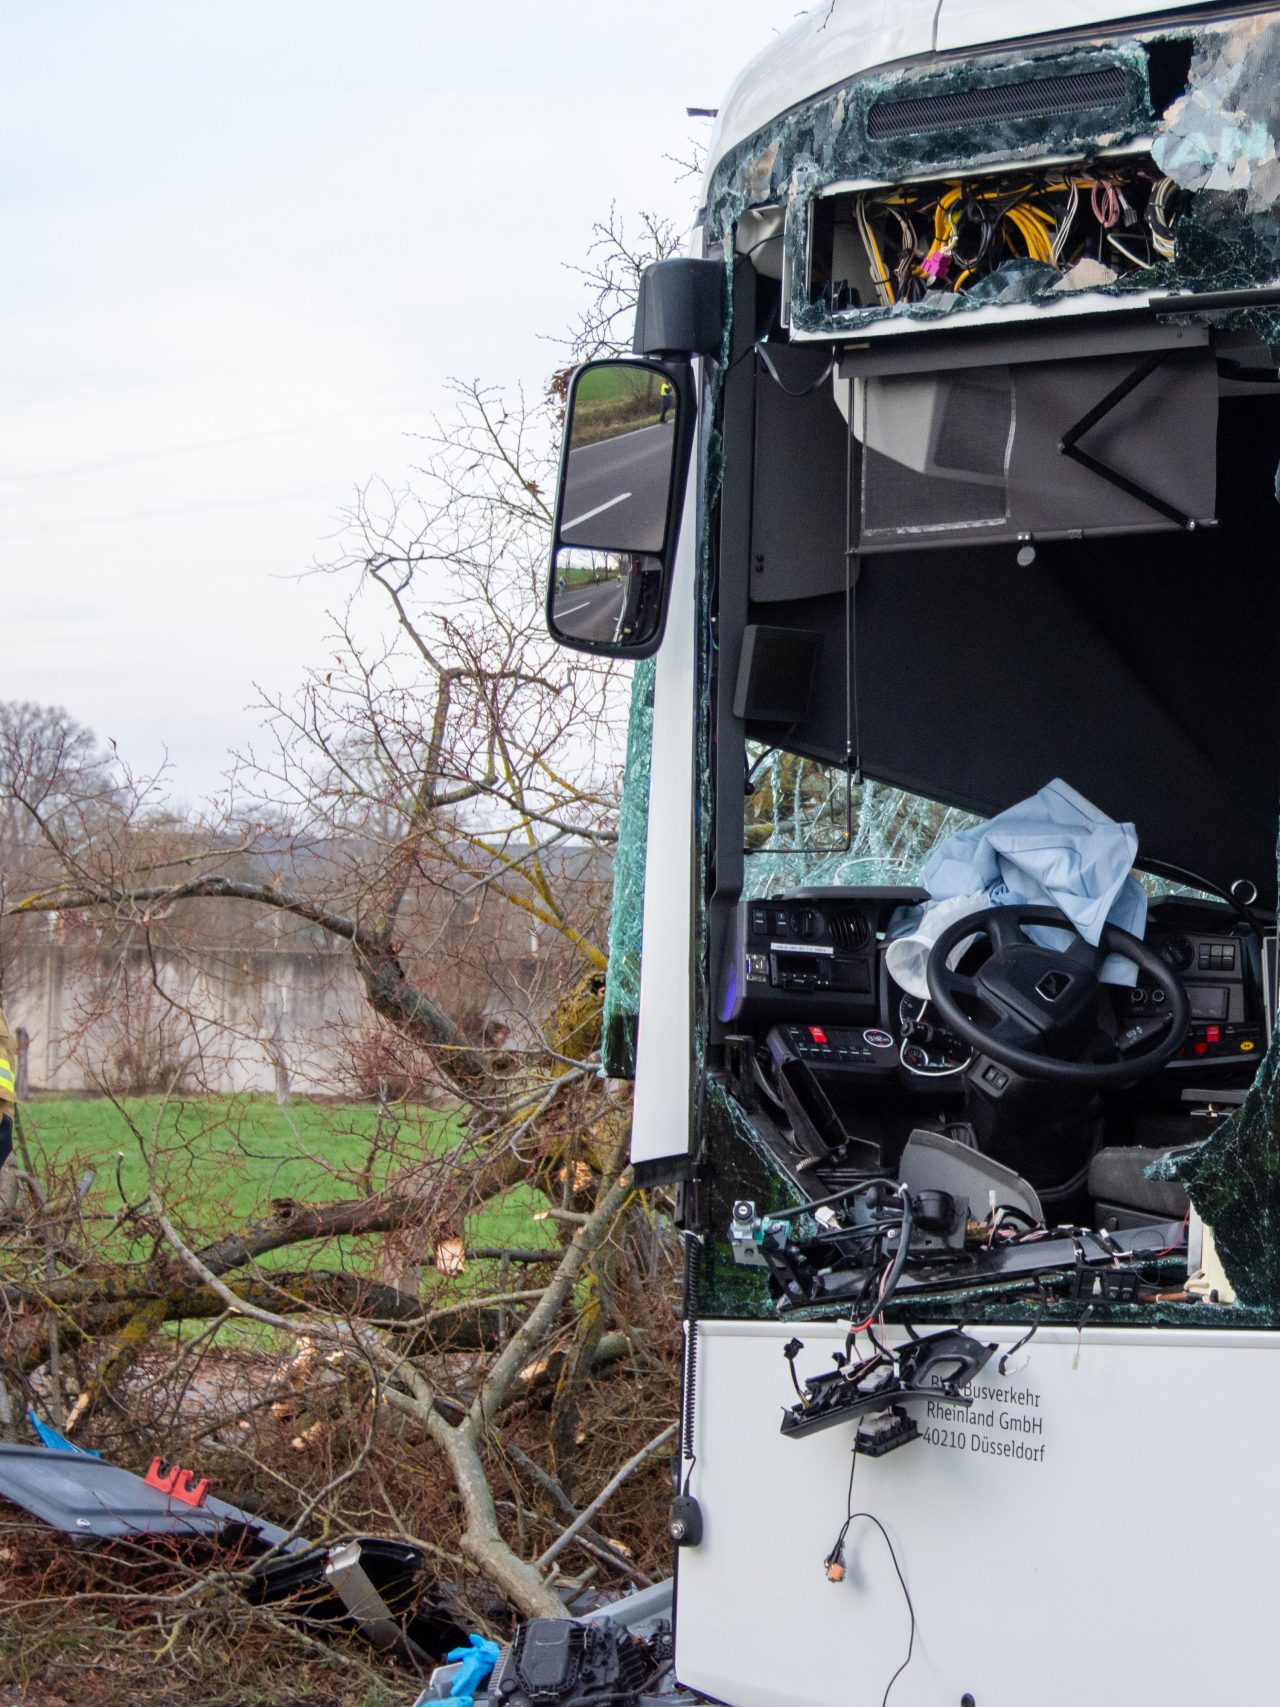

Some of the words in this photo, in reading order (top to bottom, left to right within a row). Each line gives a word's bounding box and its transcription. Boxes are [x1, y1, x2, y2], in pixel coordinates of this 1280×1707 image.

[964, 1382, 1041, 1407] Busverkehr
[927, 1400, 994, 1427] Rheinland
[1000, 1411, 1043, 1435] GmbH
[923, 1427, 966, 1450] 40210
[971, 1434, 1046, 1462] Düsseldorf
